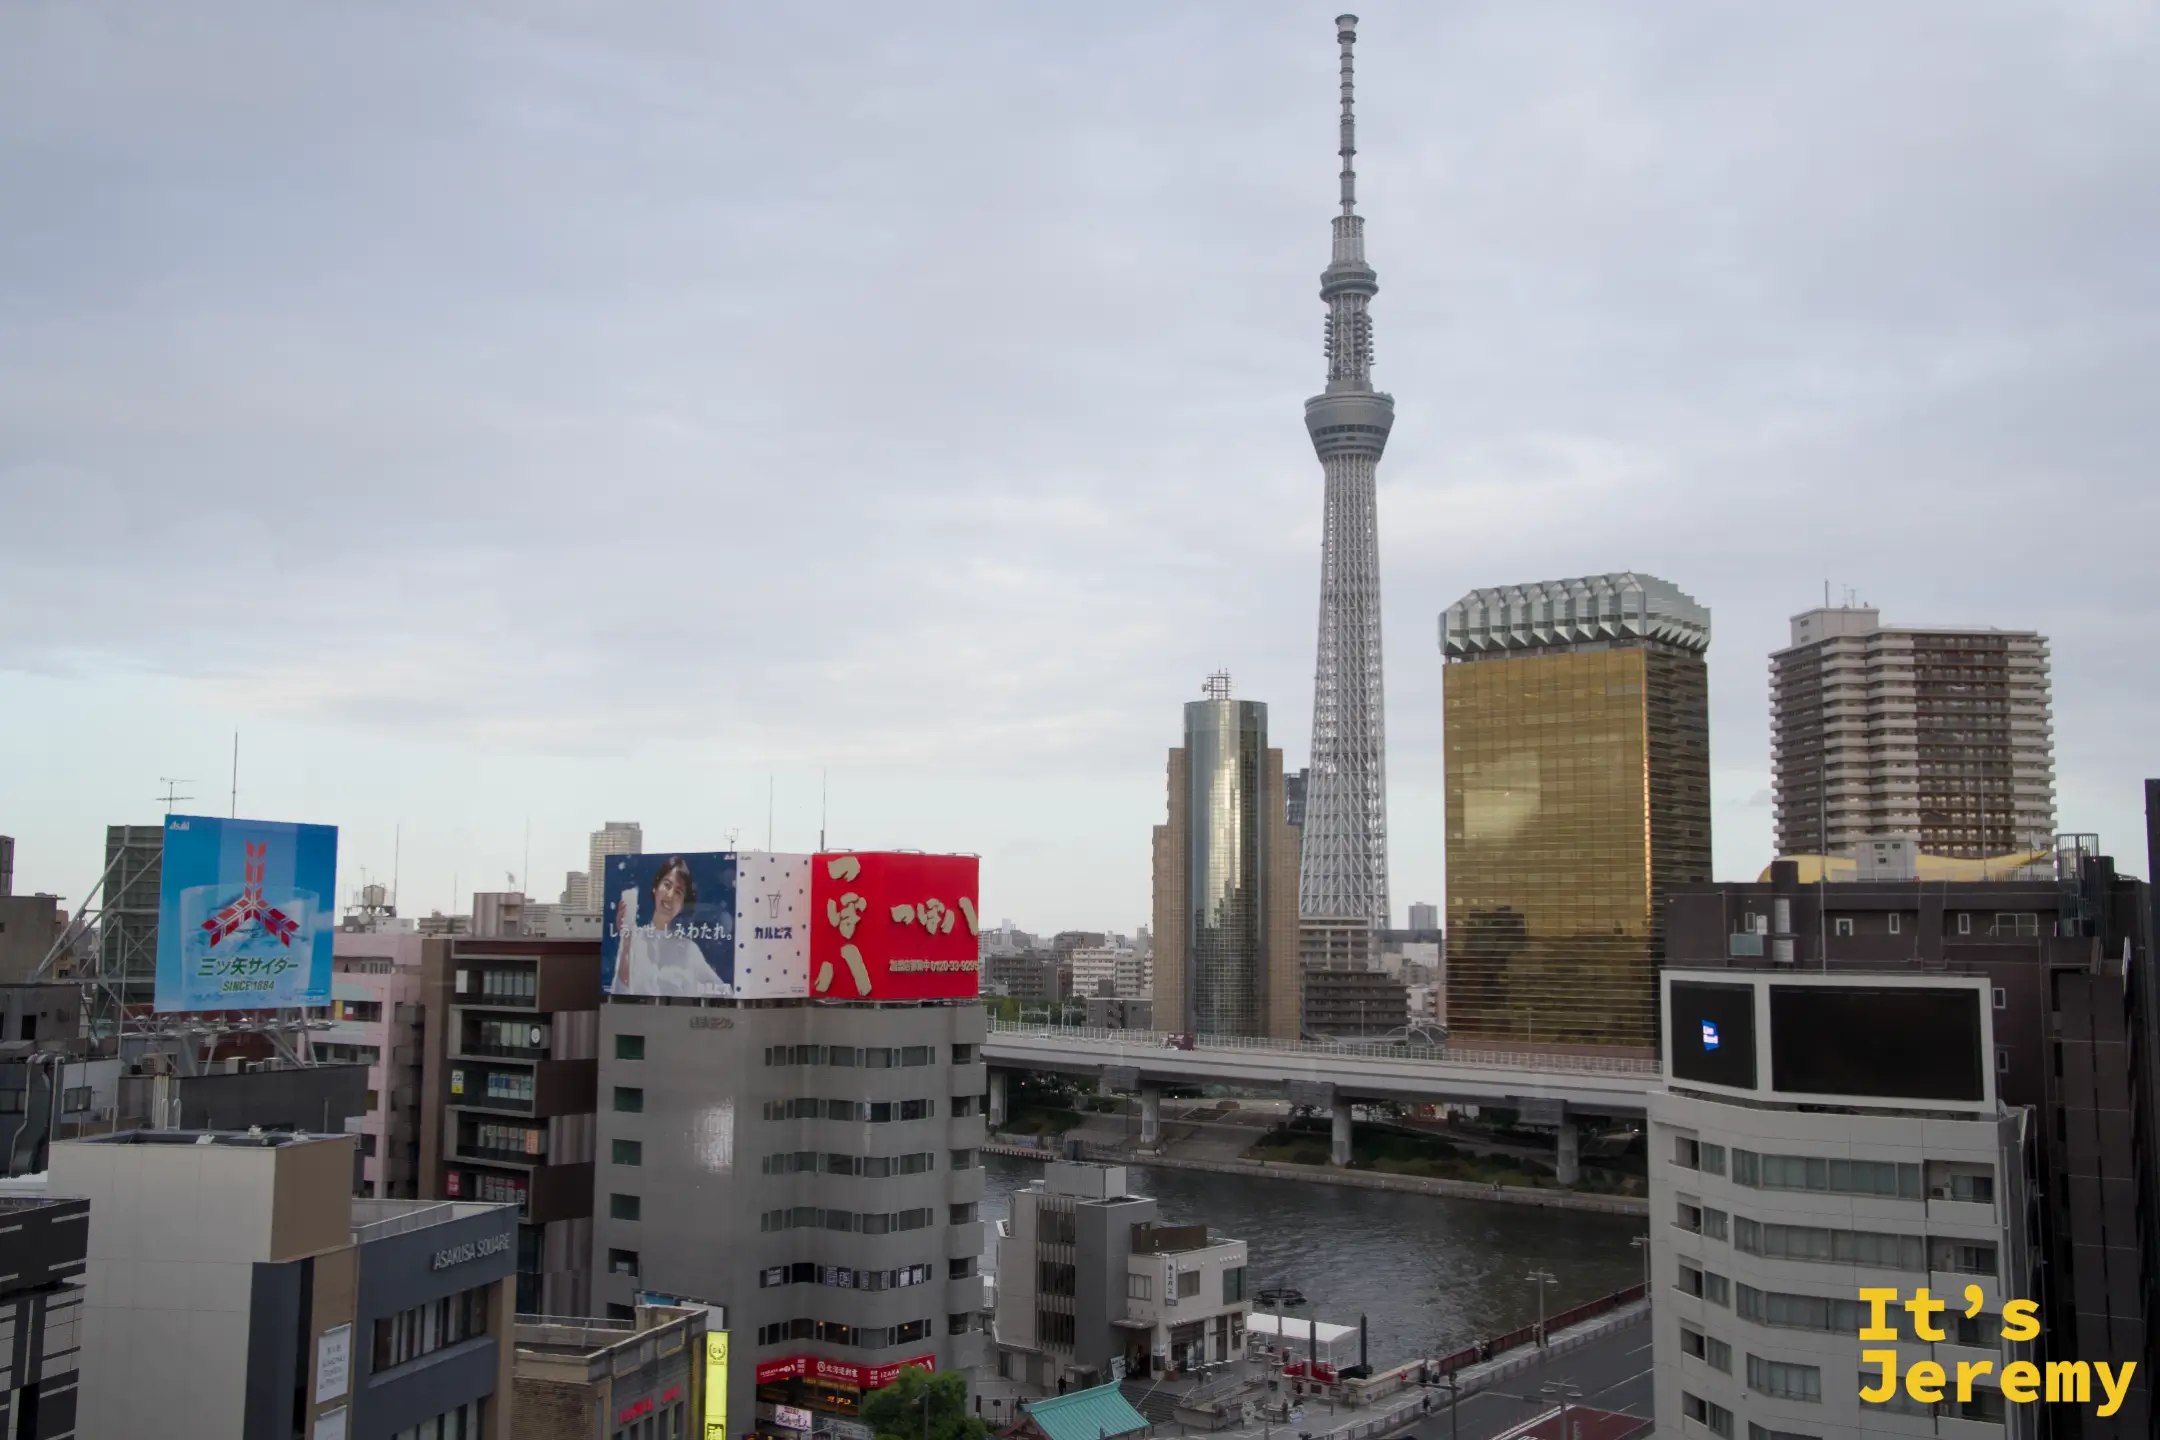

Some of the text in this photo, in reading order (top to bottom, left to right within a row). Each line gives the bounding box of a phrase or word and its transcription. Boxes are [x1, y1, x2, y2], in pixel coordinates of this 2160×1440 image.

[890, 897, 979, 936] つぼ八
[754, 926, 793, 940] カルピス
[814, 856, 873, 997] つぼ八
[198, 957, 299, 976] 三ツ矢サイダー
[222, 980, 275, 992] SINCE 1884
[433, 1232, 511, 1270] ASAKUSA SQUARE
[880, 1369, 900, 1379] IZAKA
